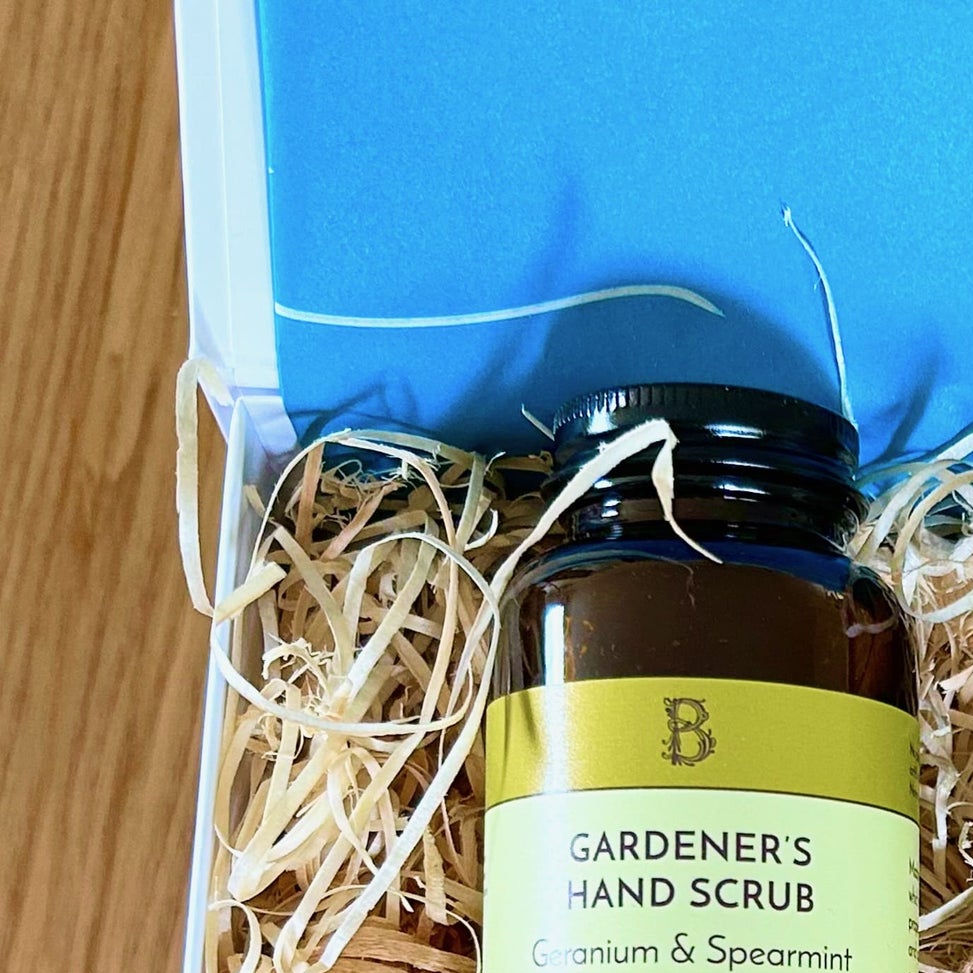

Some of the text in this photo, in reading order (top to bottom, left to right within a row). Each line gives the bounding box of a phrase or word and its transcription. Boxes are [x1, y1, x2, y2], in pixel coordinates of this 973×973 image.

[570, 830, 812, 866] GARDENER'S
[567, 877, 815, 912] HAND SCRUB
[532, 932, 853, 972] Geranium & Spearmint
